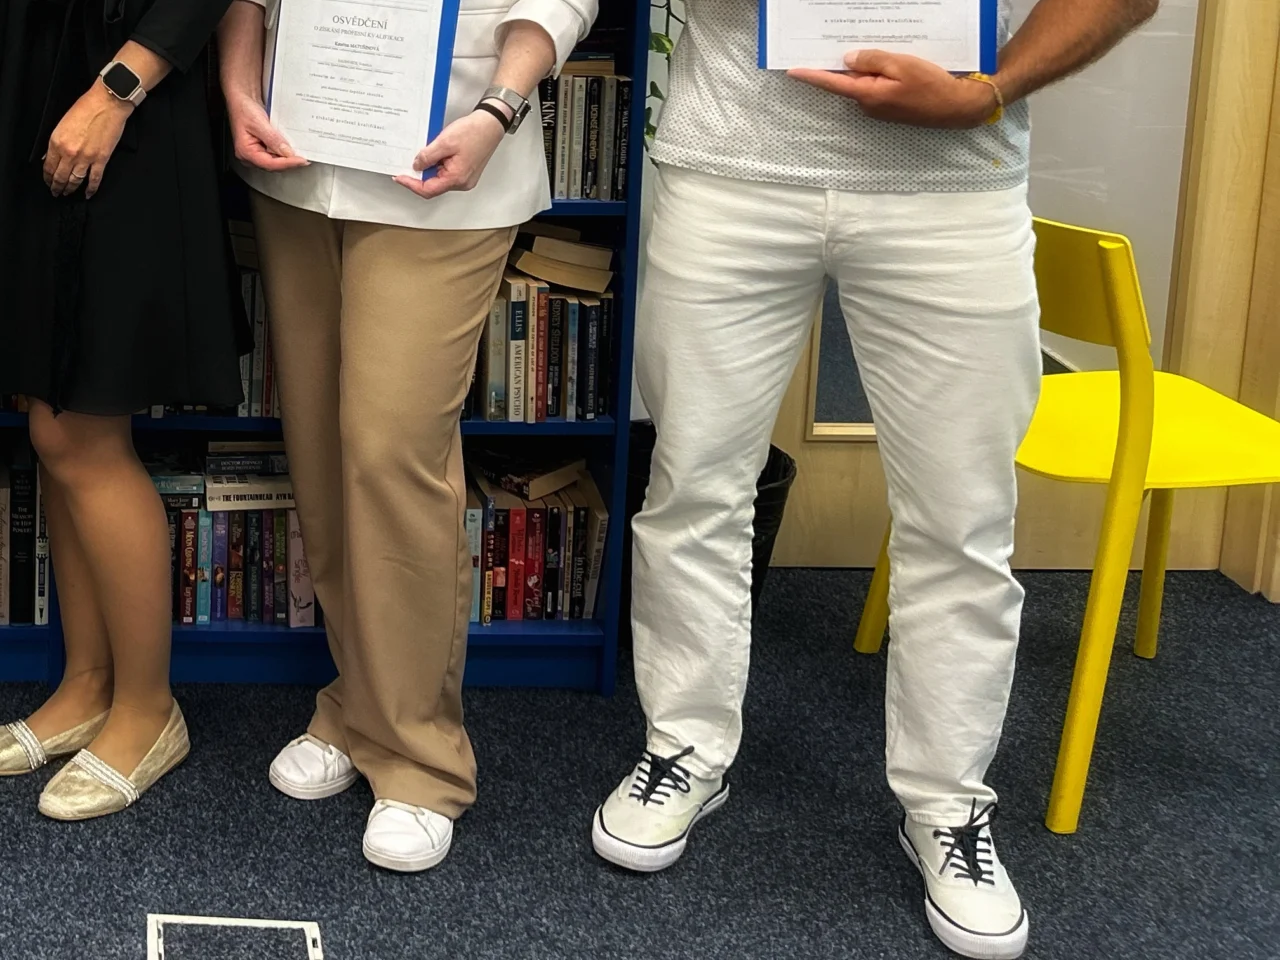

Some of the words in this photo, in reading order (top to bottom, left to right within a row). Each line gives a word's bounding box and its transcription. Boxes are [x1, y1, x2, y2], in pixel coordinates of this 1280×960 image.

[318, 24, 341, 35] ZÍSKÁNÍ
[340, 28, 367, 38] PROFESNÍ
[366, 31, 405, 43] KVALIFIKACE
[332, 14, 389, 31] OSVĚDČENÍ
[541, 100, 556, 127] KING
[590, 104, 599, 129] LICENSE
[619, 138, 628, 165] CLOUDS
[514, 309, 524, 333] ELLIS
[551, 299, 562, 327] SIDNEY
[550, 327, 563, 364] SHELDON
[513, 344, 523, 385] AMERICAN
[513, 386, 522, 416] PSYCHO
[222, 494, 232, 503] THE
[232, 493, 273, 502] FOUNTAINHEAD
[275, 493, 287, 501] AYN
